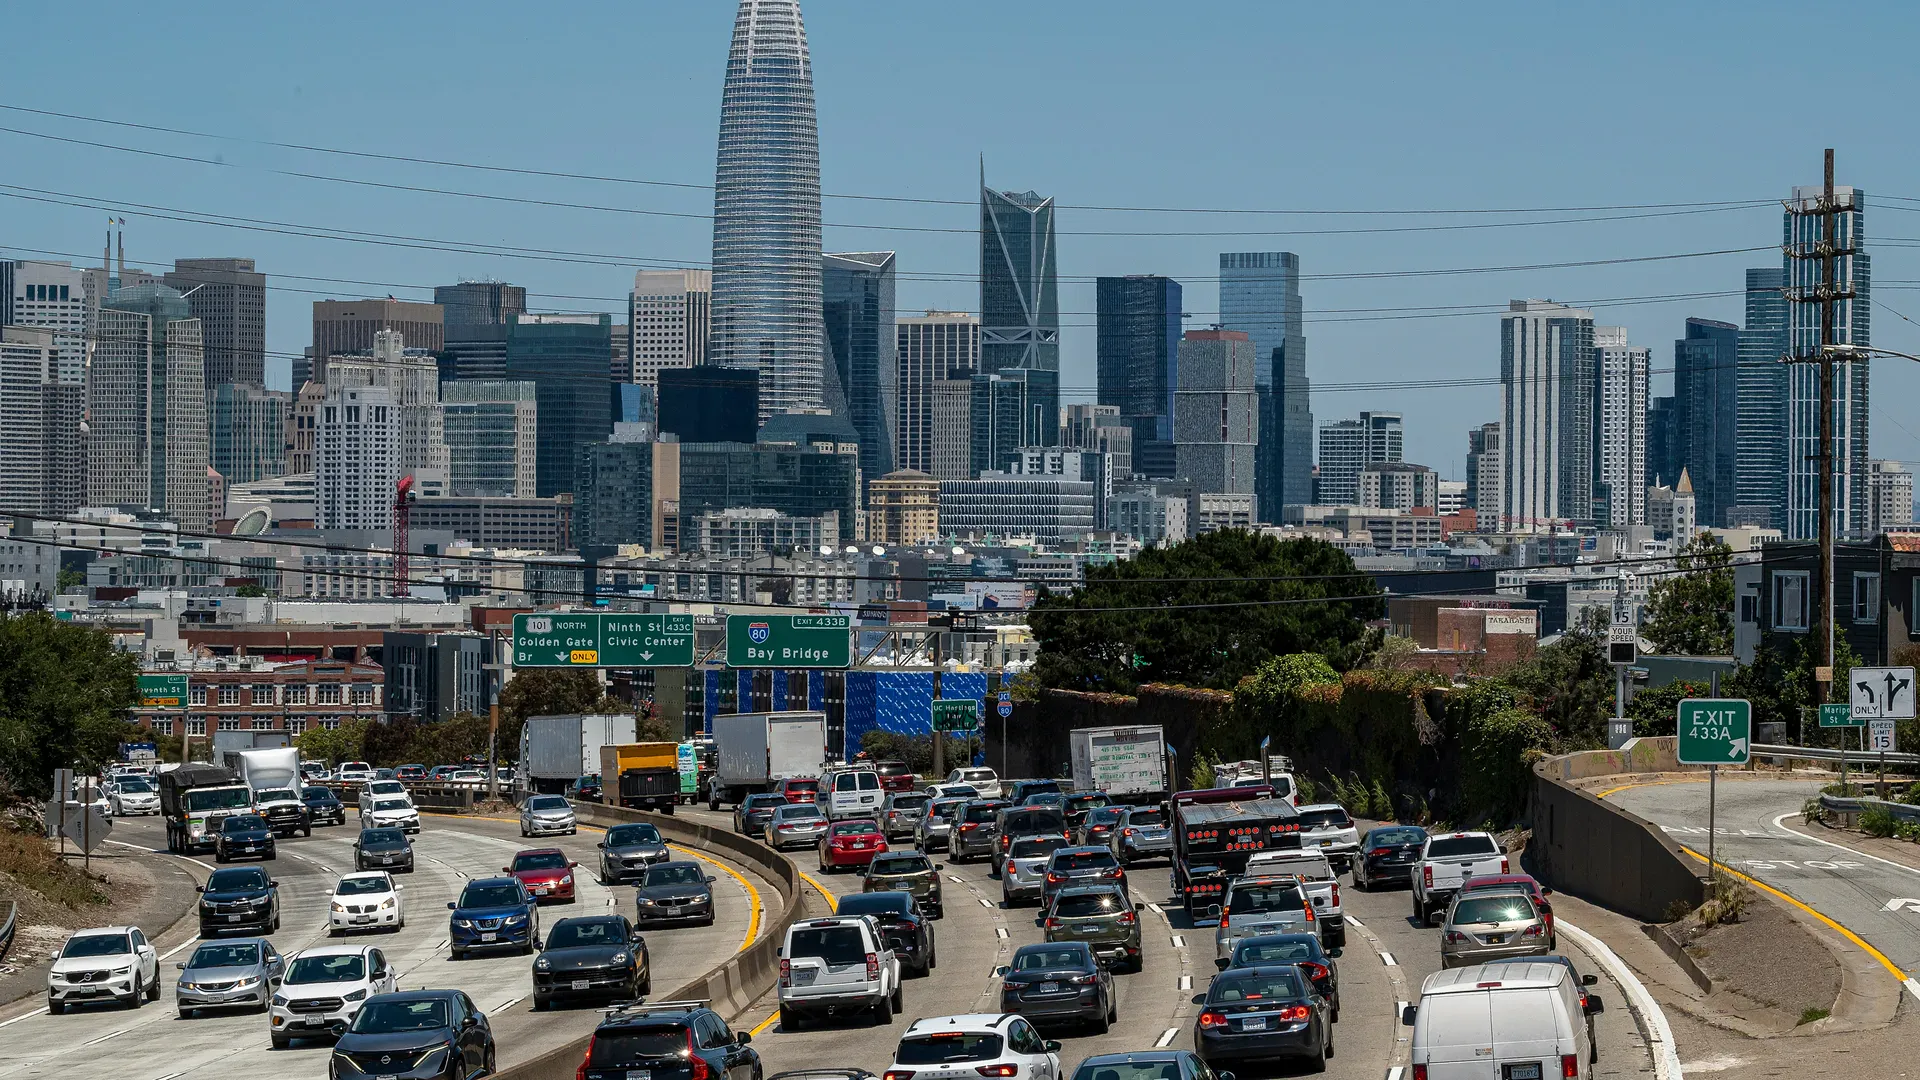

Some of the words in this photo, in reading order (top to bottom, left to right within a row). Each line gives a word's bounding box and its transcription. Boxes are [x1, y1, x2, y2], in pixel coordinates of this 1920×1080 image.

[816, 618, 845, 626] 433B
[1614, 612, 1629, 623] 15
[532, 622, 546, 630] 101
[608, 623, 641, 632] Ninth
[648, 623, 661, 632] St
[752, 629, 766, 639] 80
[519, 637, 560, 647] Golden
[566, 637, 593, 647] Gate
[608, 637, 638, 646] Civic
[645, 637, 685, 646] Center
[519, 653, 532, 662] Br
[748, 648, 774, 660] Bay
[783, 648, 829, 661] Bridge
[1855, 706, 1878, 714] ONLY
[1693, 710, 1736, 725] EXIT
[1689, 726, 1731, 740] 433A
[1874, 736, 1890, 748] 15
[1742, 860, 1864, 869] STOP
